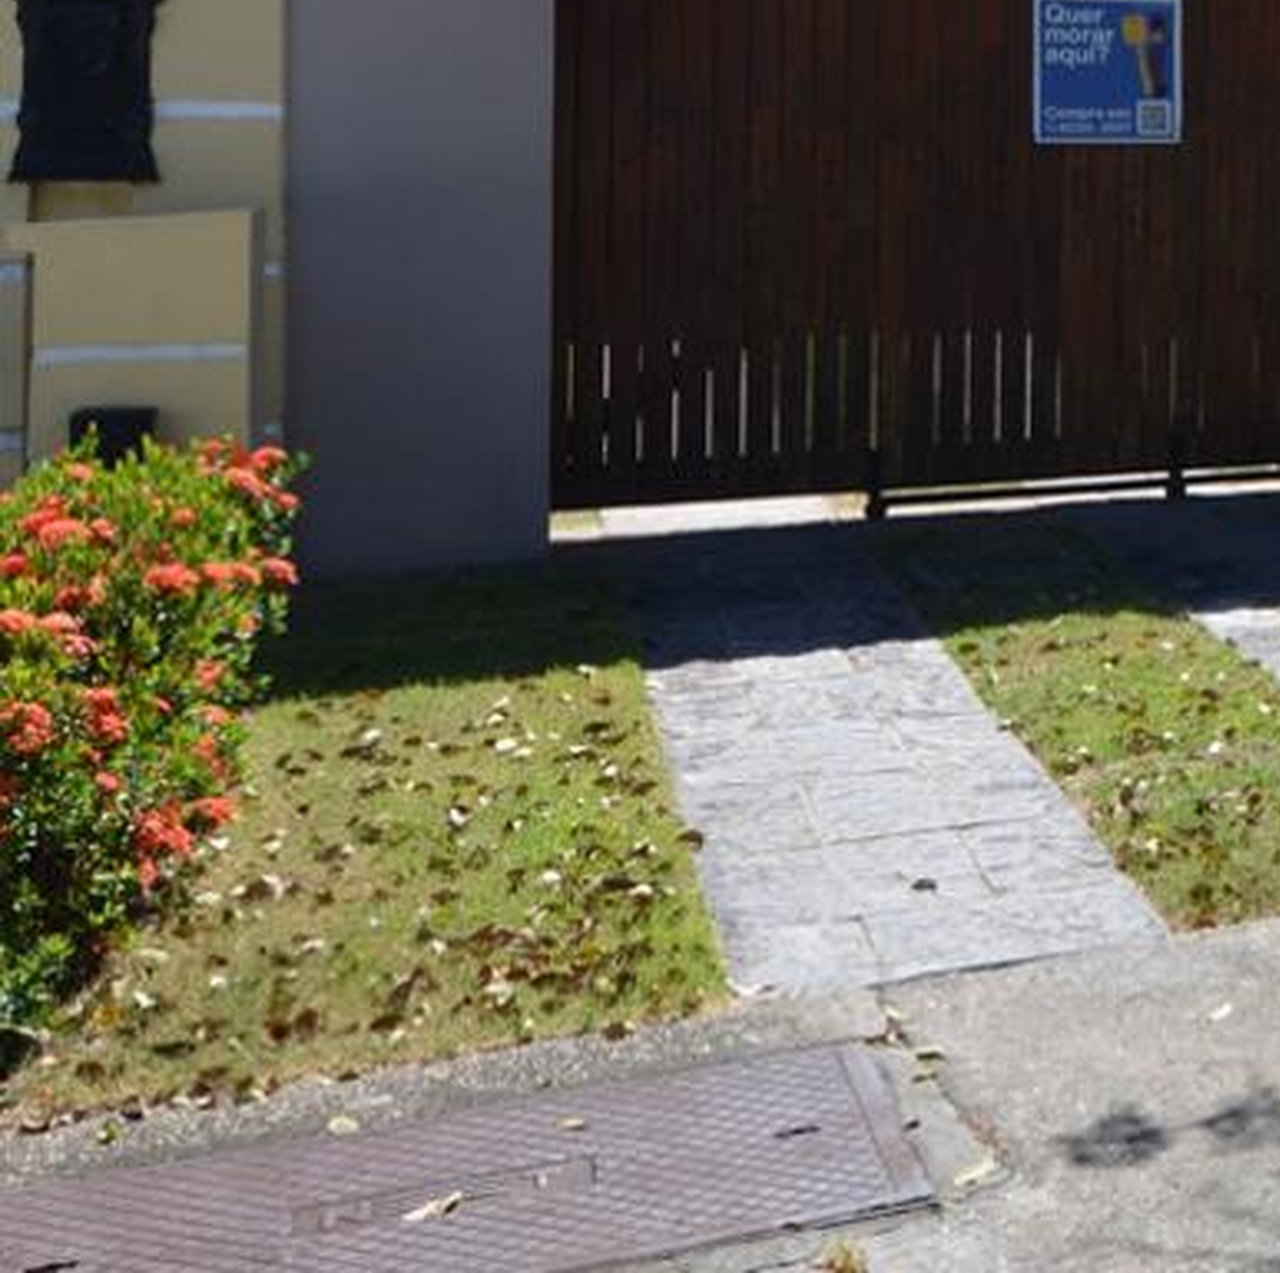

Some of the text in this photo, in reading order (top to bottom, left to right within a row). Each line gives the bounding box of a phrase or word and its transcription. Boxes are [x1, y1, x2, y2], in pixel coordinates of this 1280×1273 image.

[1045, 4, 1104, 24] Quer
[1044, 28, 1114, 43] morar
[1044, 46, 1110, 69] aqui?
